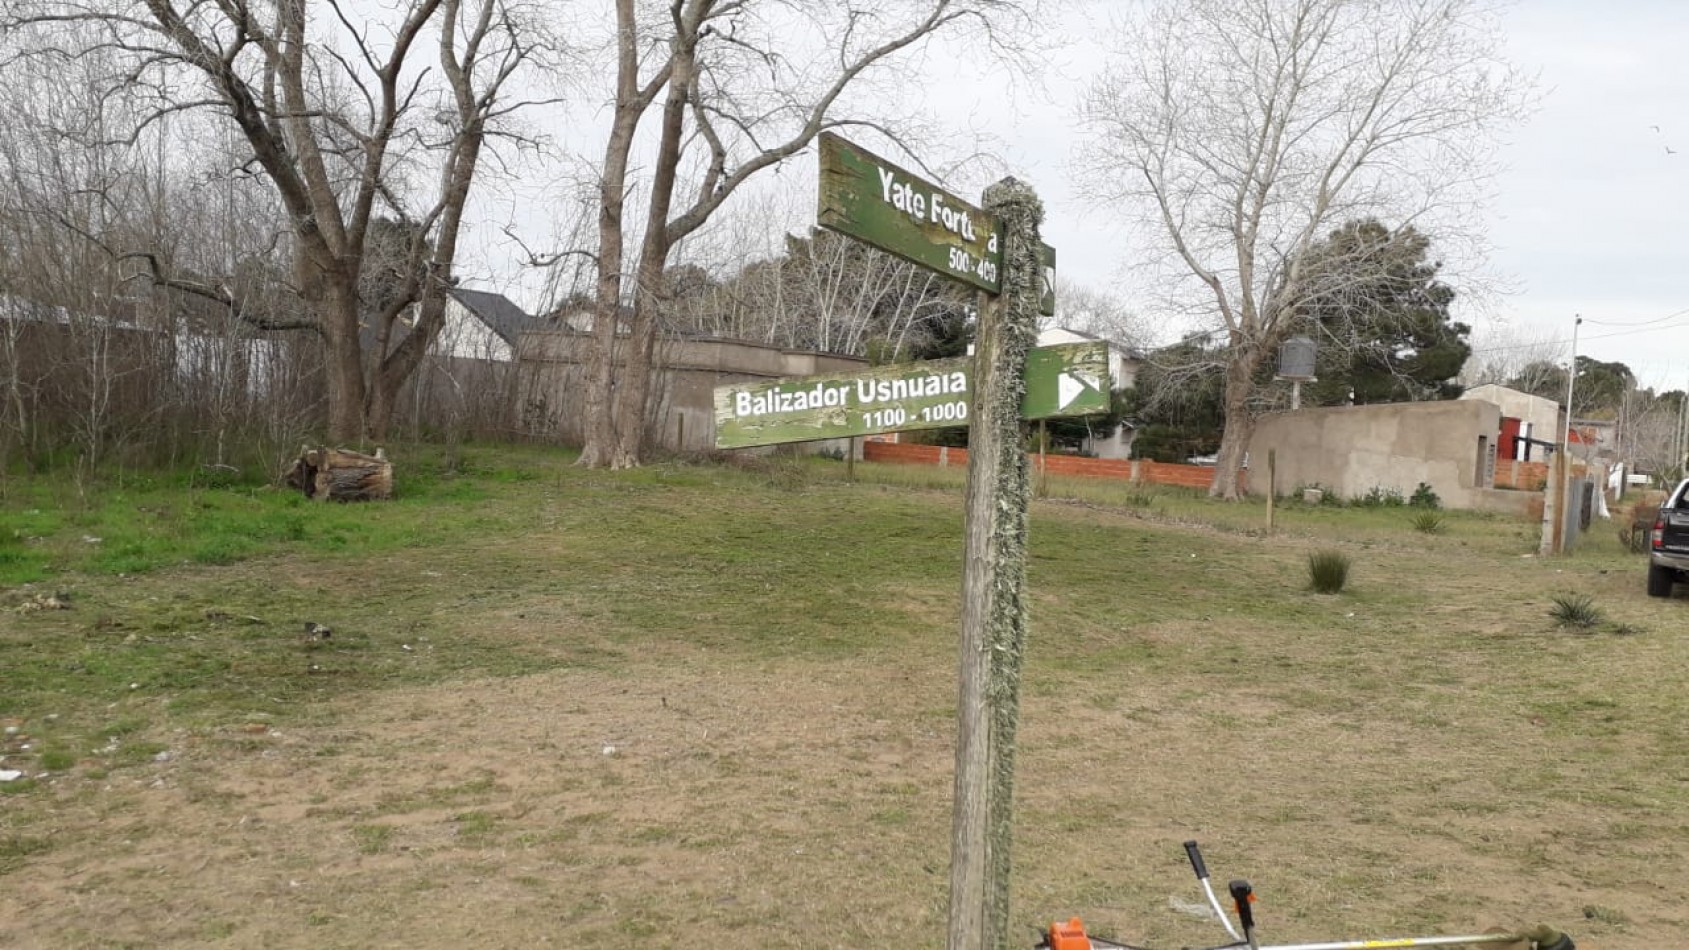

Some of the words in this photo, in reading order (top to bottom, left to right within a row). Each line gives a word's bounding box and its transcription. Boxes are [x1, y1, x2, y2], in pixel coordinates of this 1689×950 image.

[877, 166, 926, 219] Yate
[931, 194, 998, 254] Fortua
[949, 246, 970, 273] 500
[735, 382, 850, 418] Balizador
[863, 408, 906, 428] 1100
[922, 401, 967, 422] 1000
